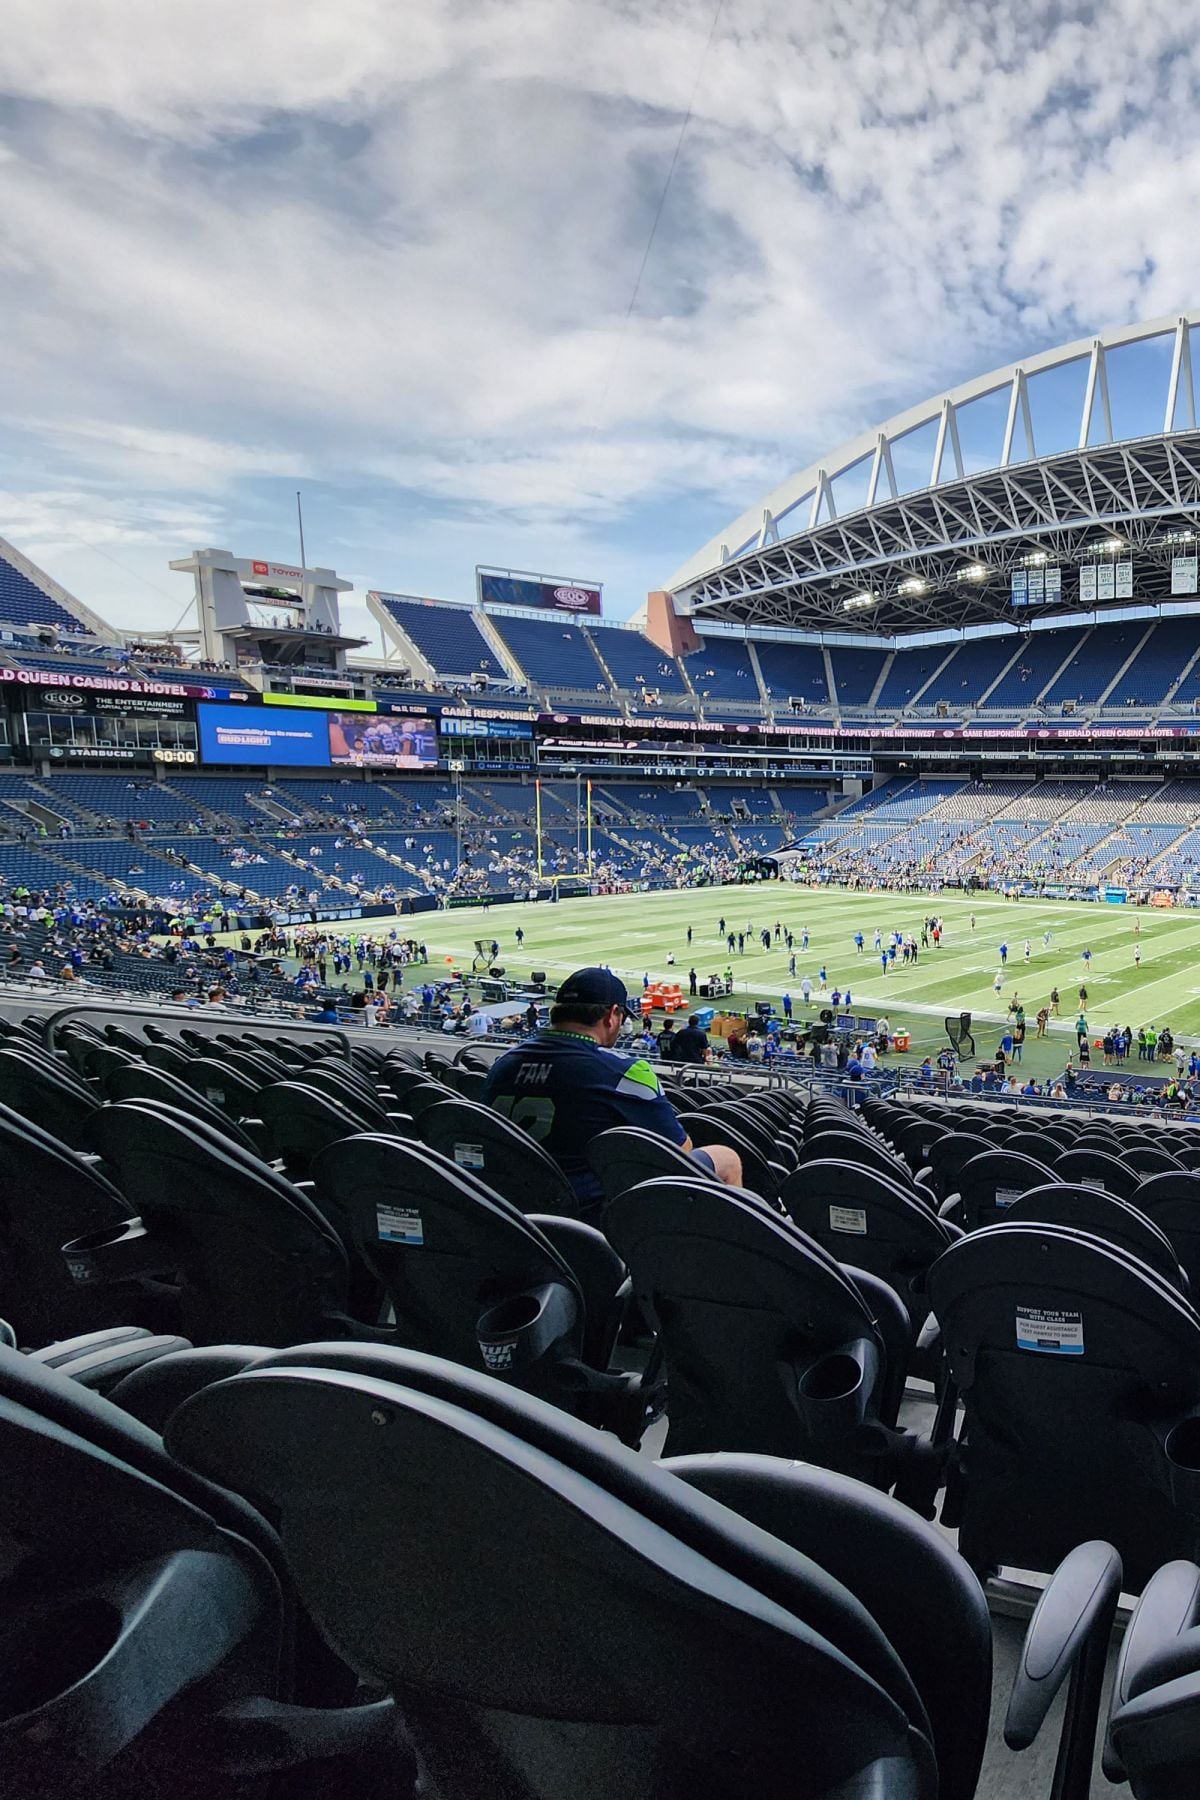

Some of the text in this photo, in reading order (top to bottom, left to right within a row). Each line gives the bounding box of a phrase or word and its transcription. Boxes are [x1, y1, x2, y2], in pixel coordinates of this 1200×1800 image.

[17, 671, 187, 696] QUEEN CASINO & HOTEL
[44, 691, 83, 705] EQC
[95, 697, 184, 709] THE ENTERTAINMENT
[441, 707, 472, 717] GAME
[473, 708, 539, 722] RESPONSIBLY
[441, 718, 489, 735] MPS
[580, 716, 725, 732] EMERALD QUEEN CASINO & HOTEL
[489, 728, 533, 738] Power Systems
[758, 725, 936, 738] THE ENTERTAINMENT CAPITAL OF THE NORTHWEST
[962, 730, 1028, 738] GAME RESPONSIBLY
[1057, 730, 1091, 738] EMERALD
[1092, 729, 1116, 738] QUEEN
[1117, 729, 1145, 737] CASINO
[1145, 729, 1151, 737] &
[1152, 729, 1174, 737] HOTEL
[220, 736, 269, 745] BUD LIGHT
[69, 749, 134, 758] STARBUCKS
[154, 751, 195, 763] 90:00
[643, 767, 785, 778] HOME OF THE 12s
[897, 1038, 905, 1046] G
[515, 1063, 553, 1085] FAN
[1016, 1306, 1041, 1316] SUPPORT
[1043, 1309, 1059, 1317] YOUR
